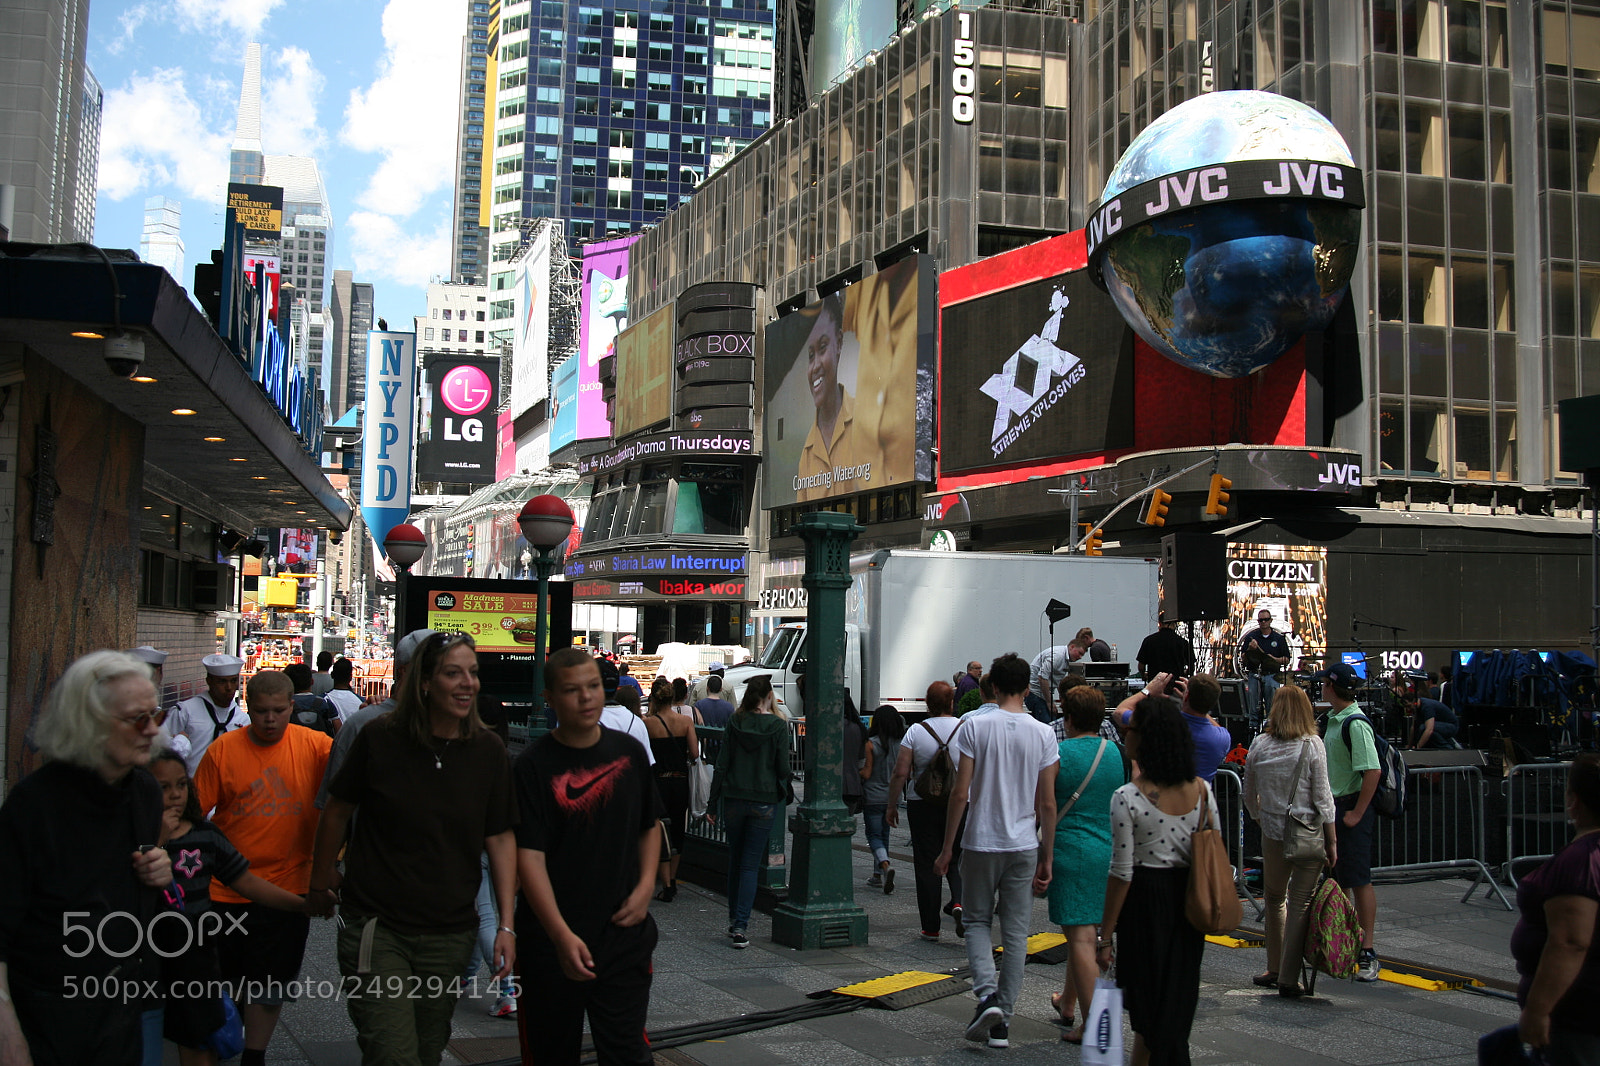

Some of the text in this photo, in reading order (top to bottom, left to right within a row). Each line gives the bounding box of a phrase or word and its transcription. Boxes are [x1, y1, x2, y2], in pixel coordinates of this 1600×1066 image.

[952, 12, 974, 122] 1500
[1145, 167, 1228, 216] JVC
[1263, 162, 1344, 199] JVC
[229, 199, 272, 209] RETIREMENT
[230, 192, 248, 200] YOUR
[250, 221, 276, 230] CAREER
[1087, 198, 1122, 256] JVC
[677, 334, 752, 363] BLACK BOX
[375, 338, 405, 502] NYPD
[991, 363, 1086, 459] XTREME XPLOSIVES
[444, 417, 484, 442] LG
[636, 440, 667, 456] Drama
[669, 434, 751, 454] Thursdays
[792, 462, 871, 491] Connecting Water.org
[1318, 462, 1362, 487] JVC
[923, 503, 943, 520] JVC
[612, 555, 638, 571] Sharia
[641, 554, 667, 570] Law
[463, 594, 505, 602] Madness
[618, 582, 644, 594] ESPN
[660, 580, 705, 595] Ibaka
[709, 583, 745, 595] wor
[1270, 587, 1293, 596] FALL
[462, 600, 505, 611] SALE
[1379, 650, 1423, 670] 1500
